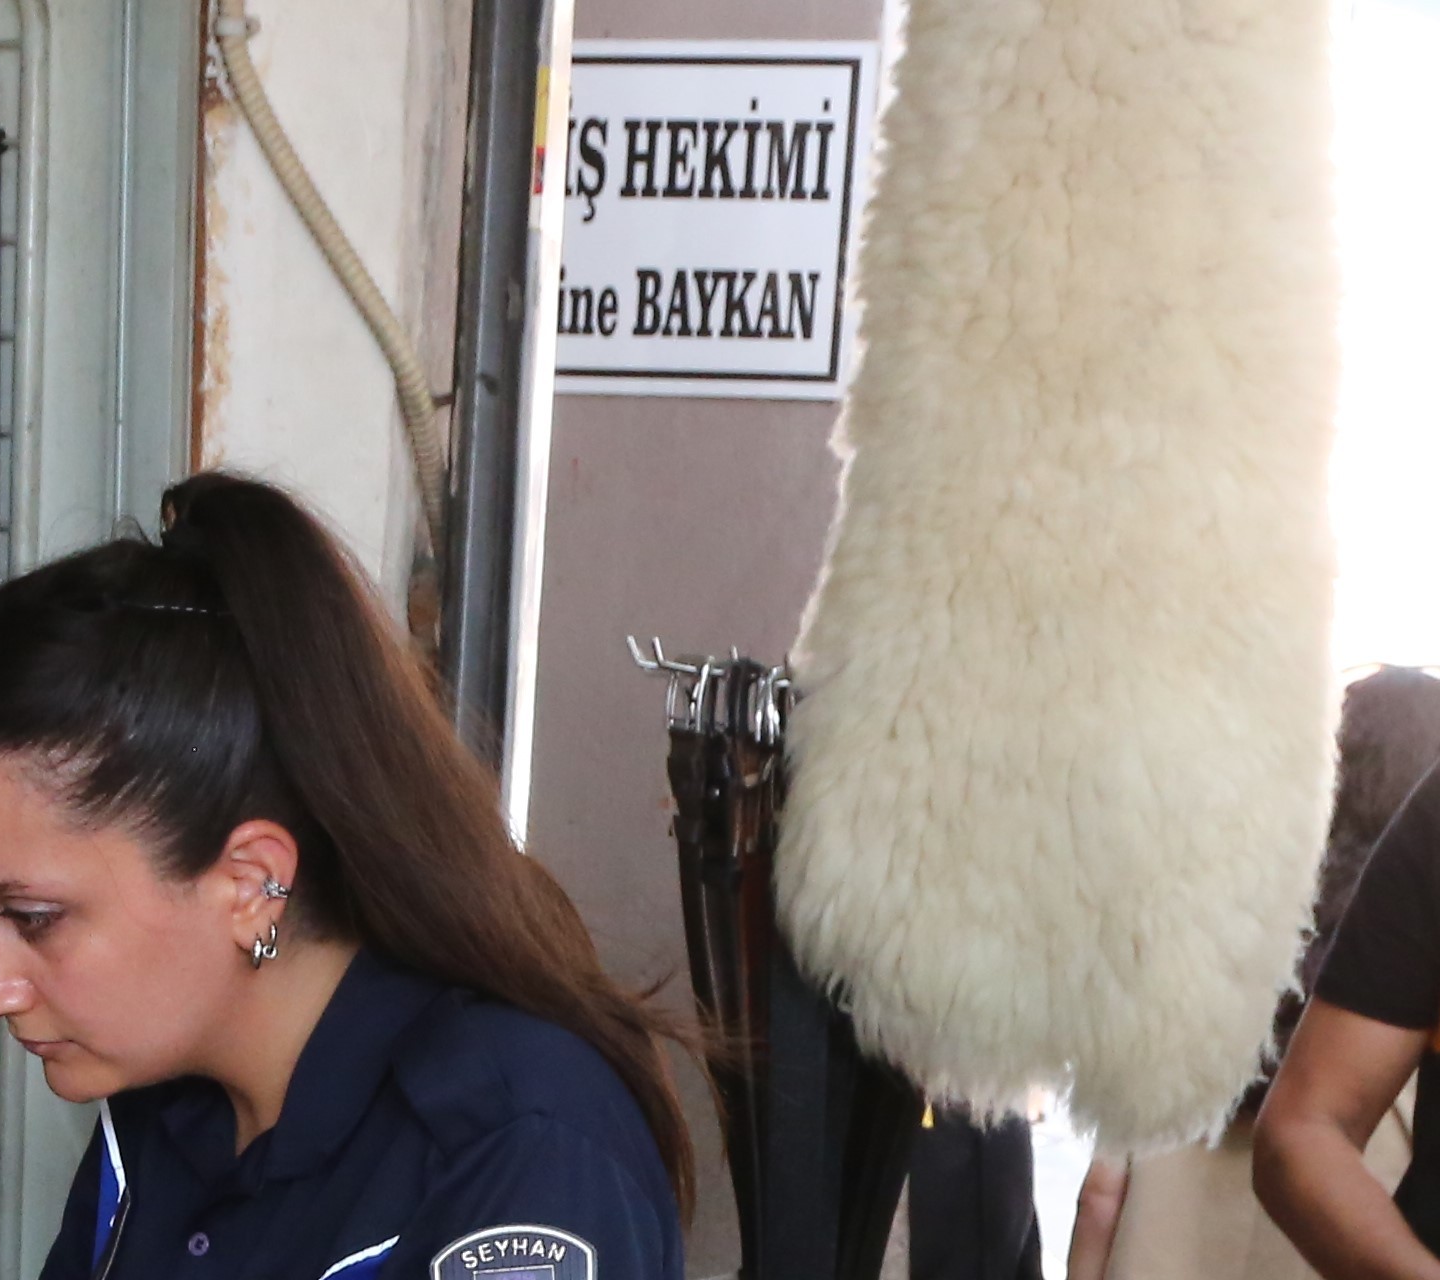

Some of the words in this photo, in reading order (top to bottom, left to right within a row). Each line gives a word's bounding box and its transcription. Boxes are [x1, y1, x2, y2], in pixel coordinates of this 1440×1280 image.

[620, 96, 834, 200] HEKİMİ
[633, 267, 820, 339] BAYKAN
[461, 1238, 567, 1269] SEYHAN
